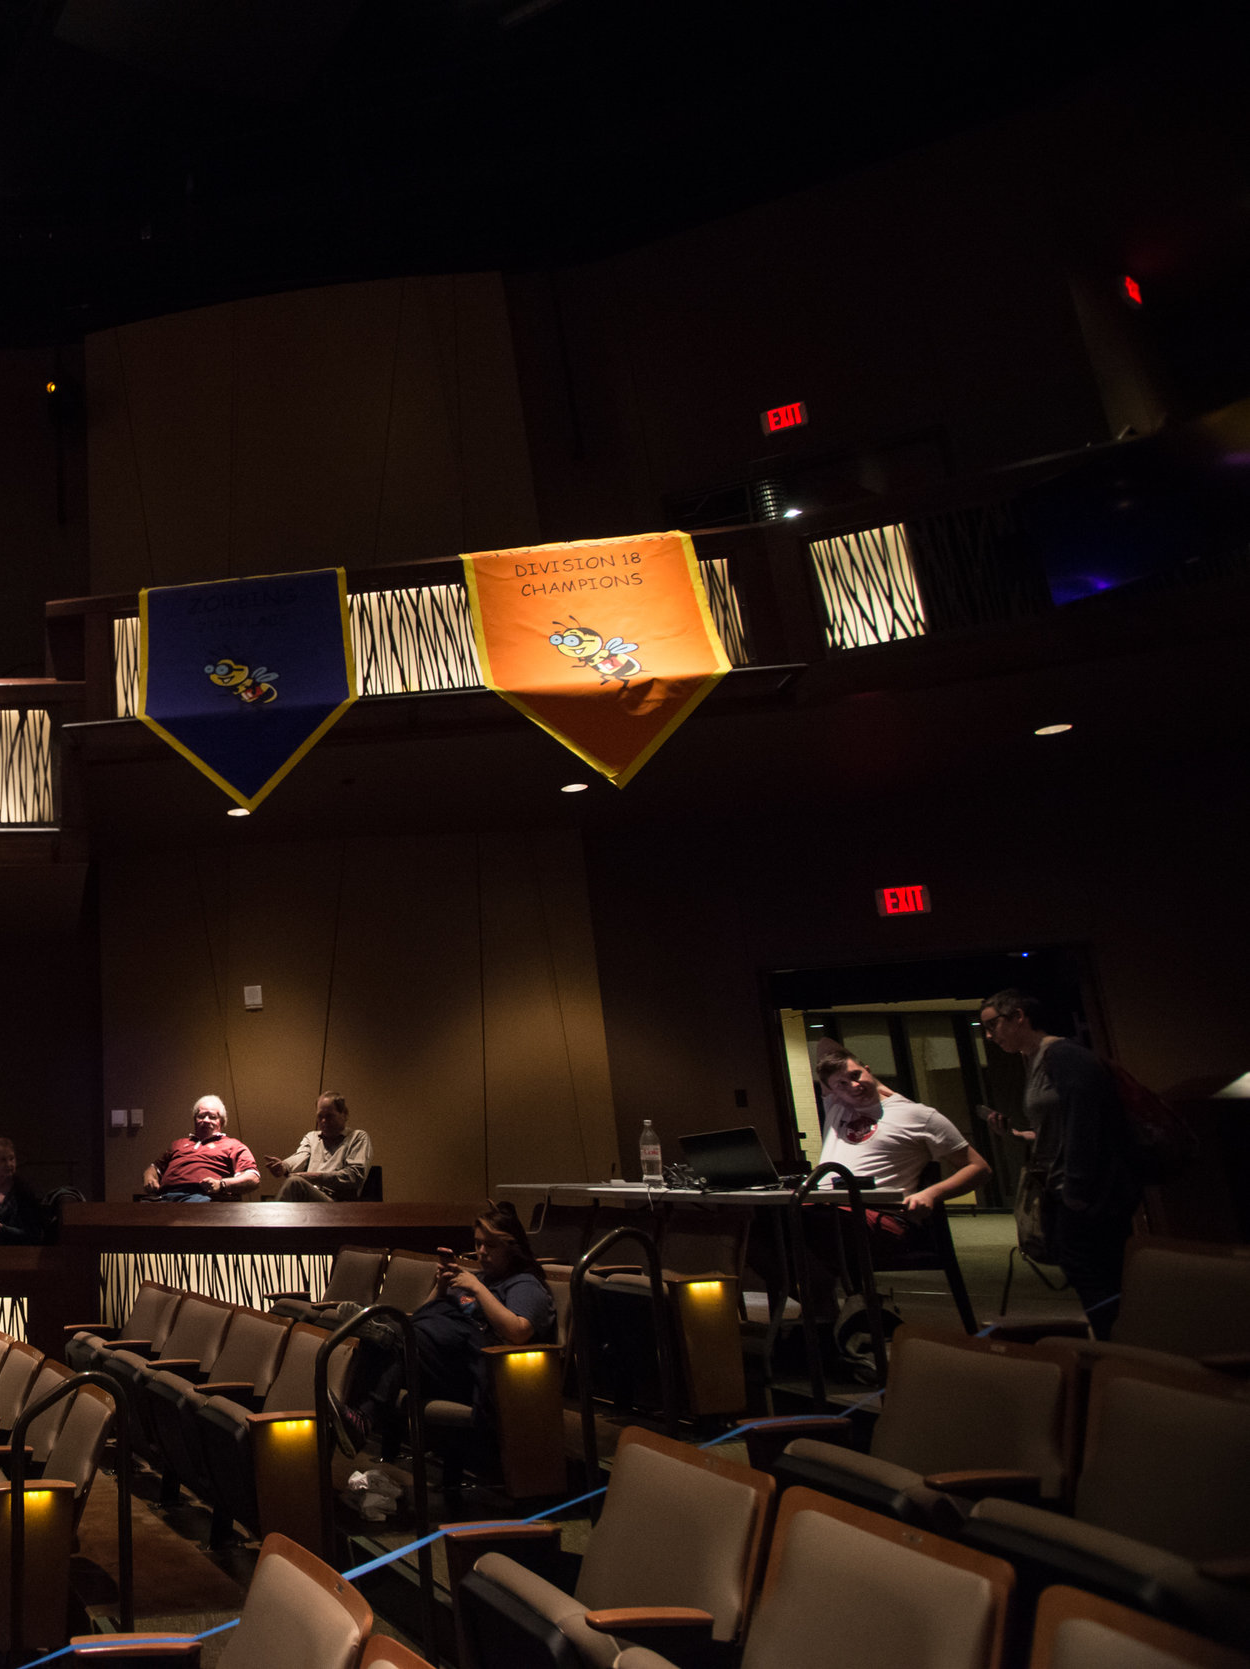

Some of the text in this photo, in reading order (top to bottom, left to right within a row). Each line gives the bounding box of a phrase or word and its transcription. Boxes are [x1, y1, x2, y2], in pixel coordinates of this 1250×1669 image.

[767, 402, 802, 431] EXIT
[514, 552, 642, 578] DIVISION 18
[520, 572, 643, 597] CHAMPIONS
[883, 885, 924, 914] EXIT
